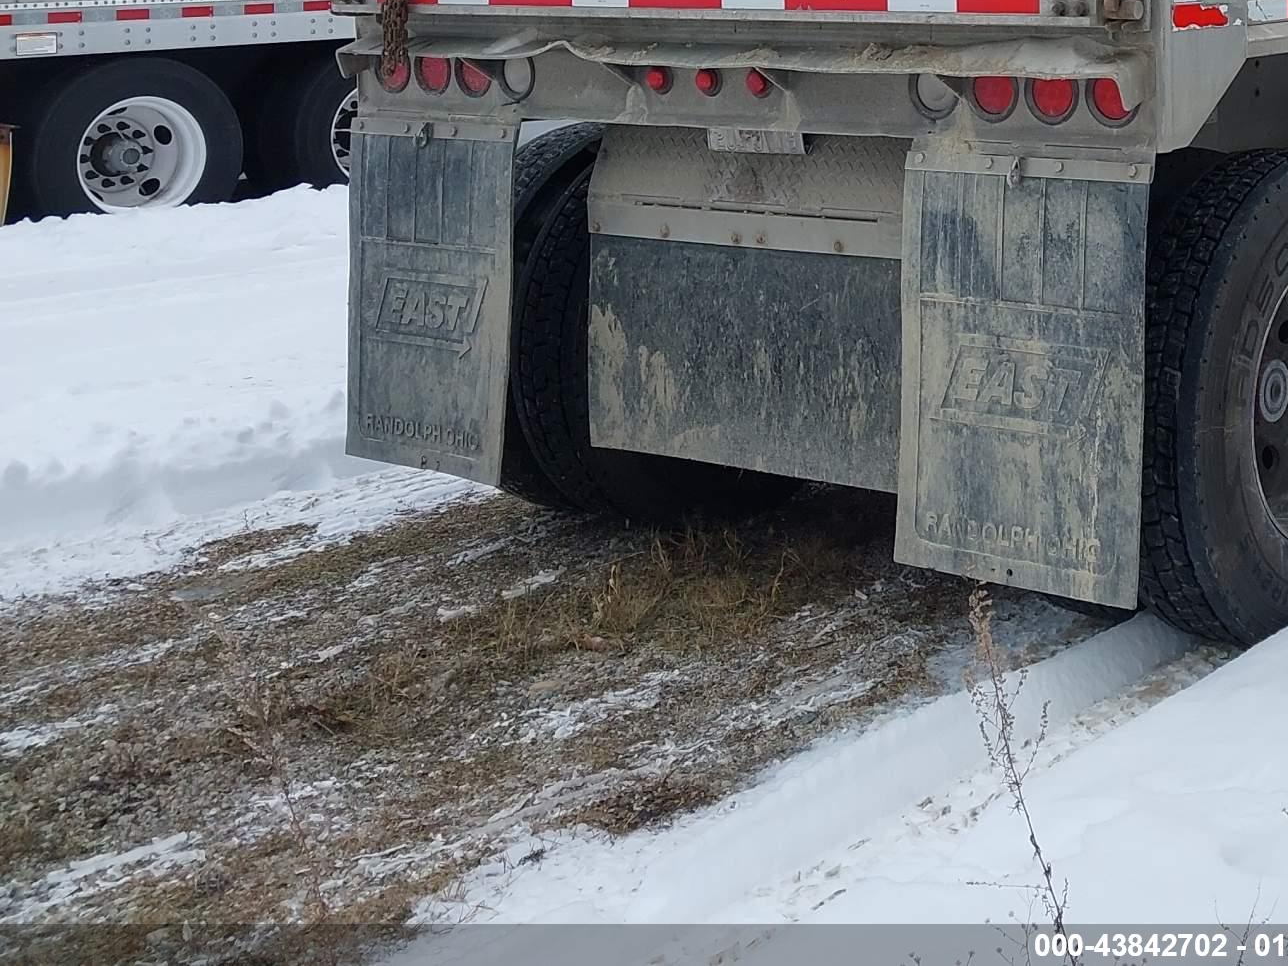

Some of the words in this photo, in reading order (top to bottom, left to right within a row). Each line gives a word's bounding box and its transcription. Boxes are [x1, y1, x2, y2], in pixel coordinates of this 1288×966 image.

[391, 283, 469, 331] EAST
[953, 357, 1083, 412] EAST
[365, 414, 442, 443] RANDOLPH
[925, 513, 1040, 553] RANDOLPH
